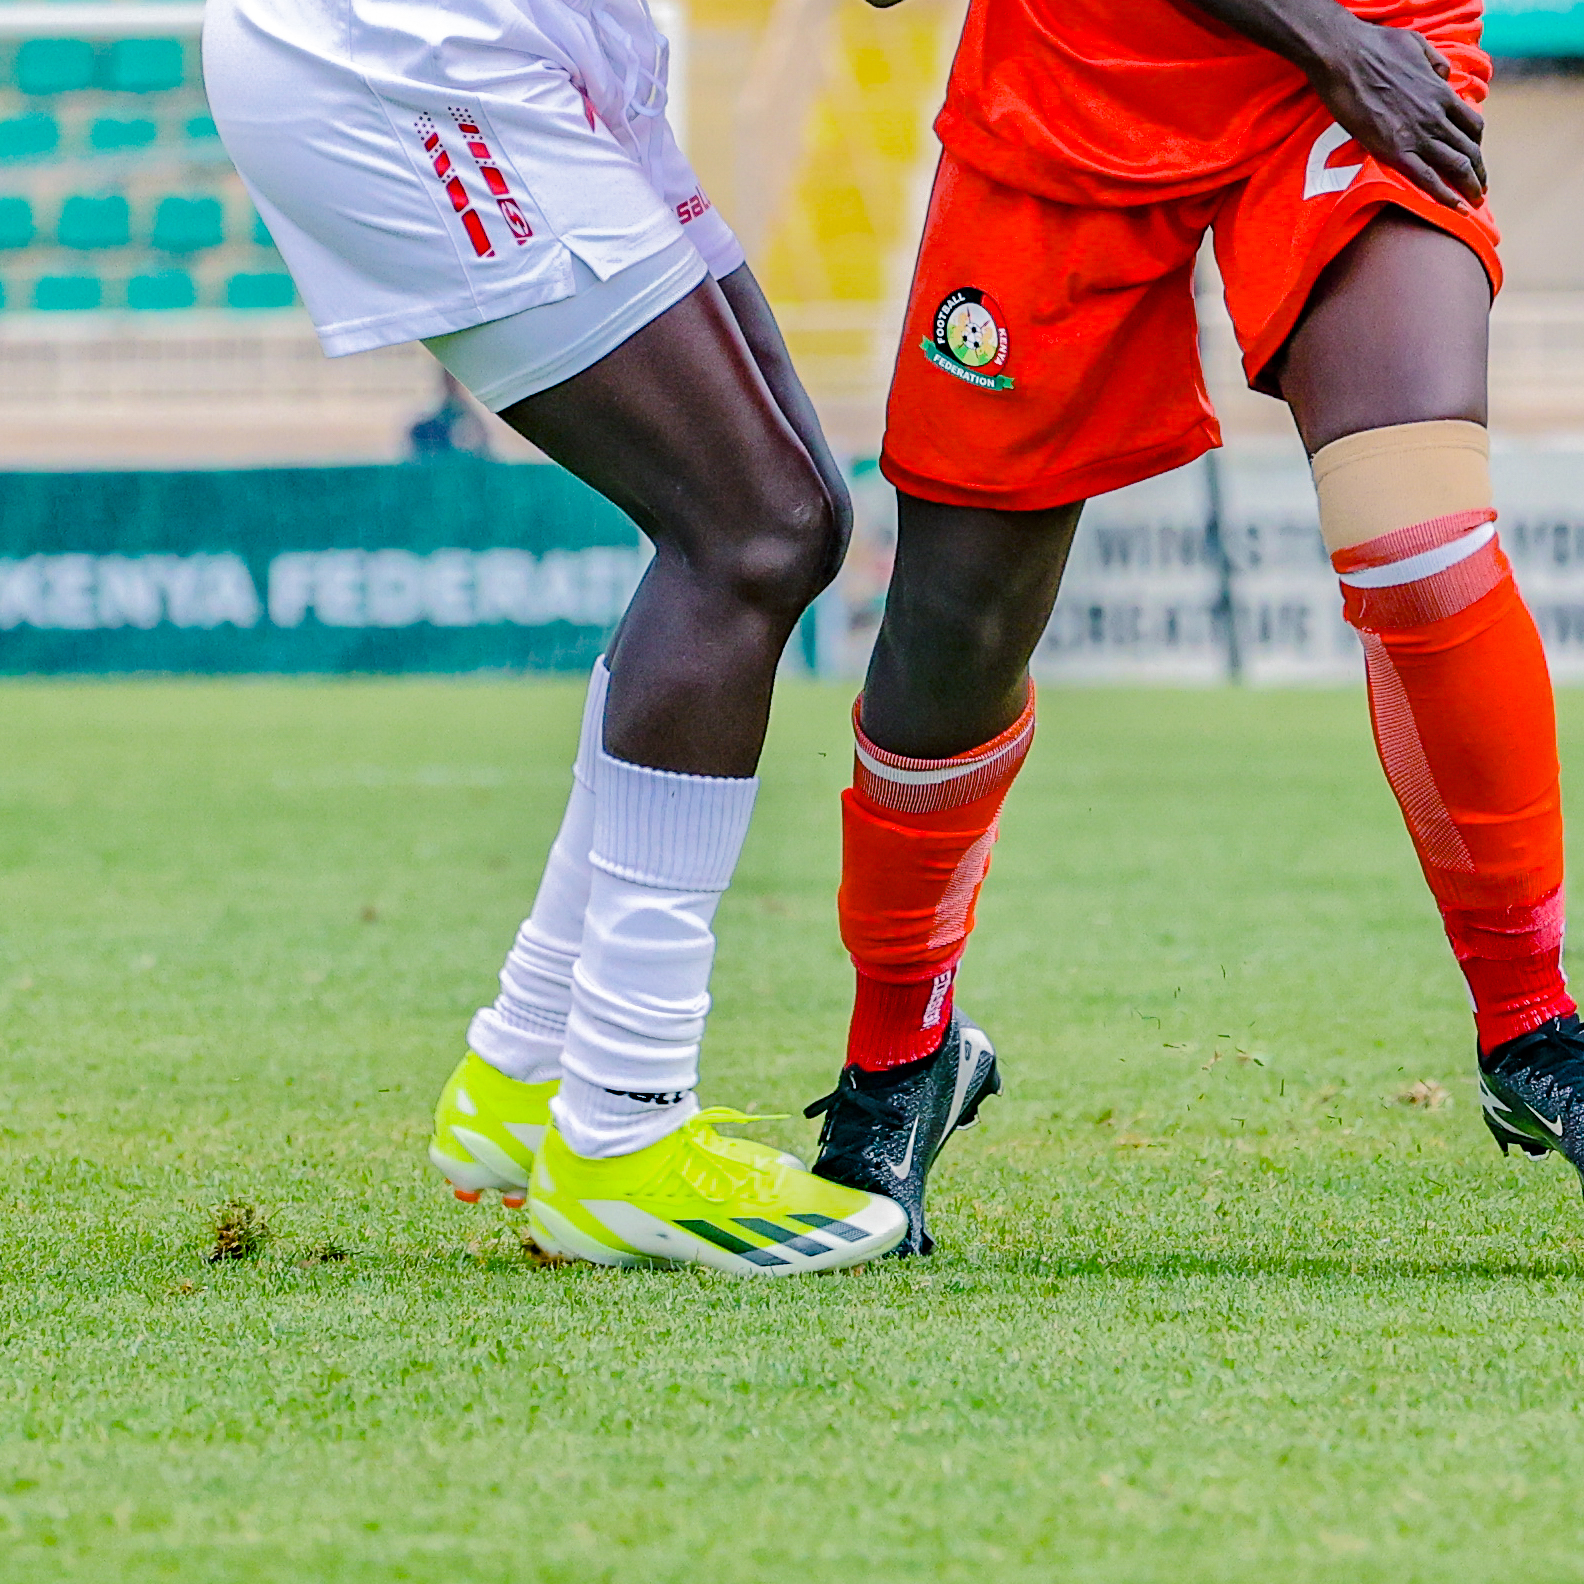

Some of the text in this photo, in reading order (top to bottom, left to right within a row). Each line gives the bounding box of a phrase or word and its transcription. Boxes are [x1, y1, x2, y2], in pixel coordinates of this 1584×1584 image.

[936, 292, 966, 344] FOOTBALL
[993, 327, 1008, 365] KENYA
[933, 354, 995, 387] FEDERATION
[267, 546, 634, 628] FEDERAT
